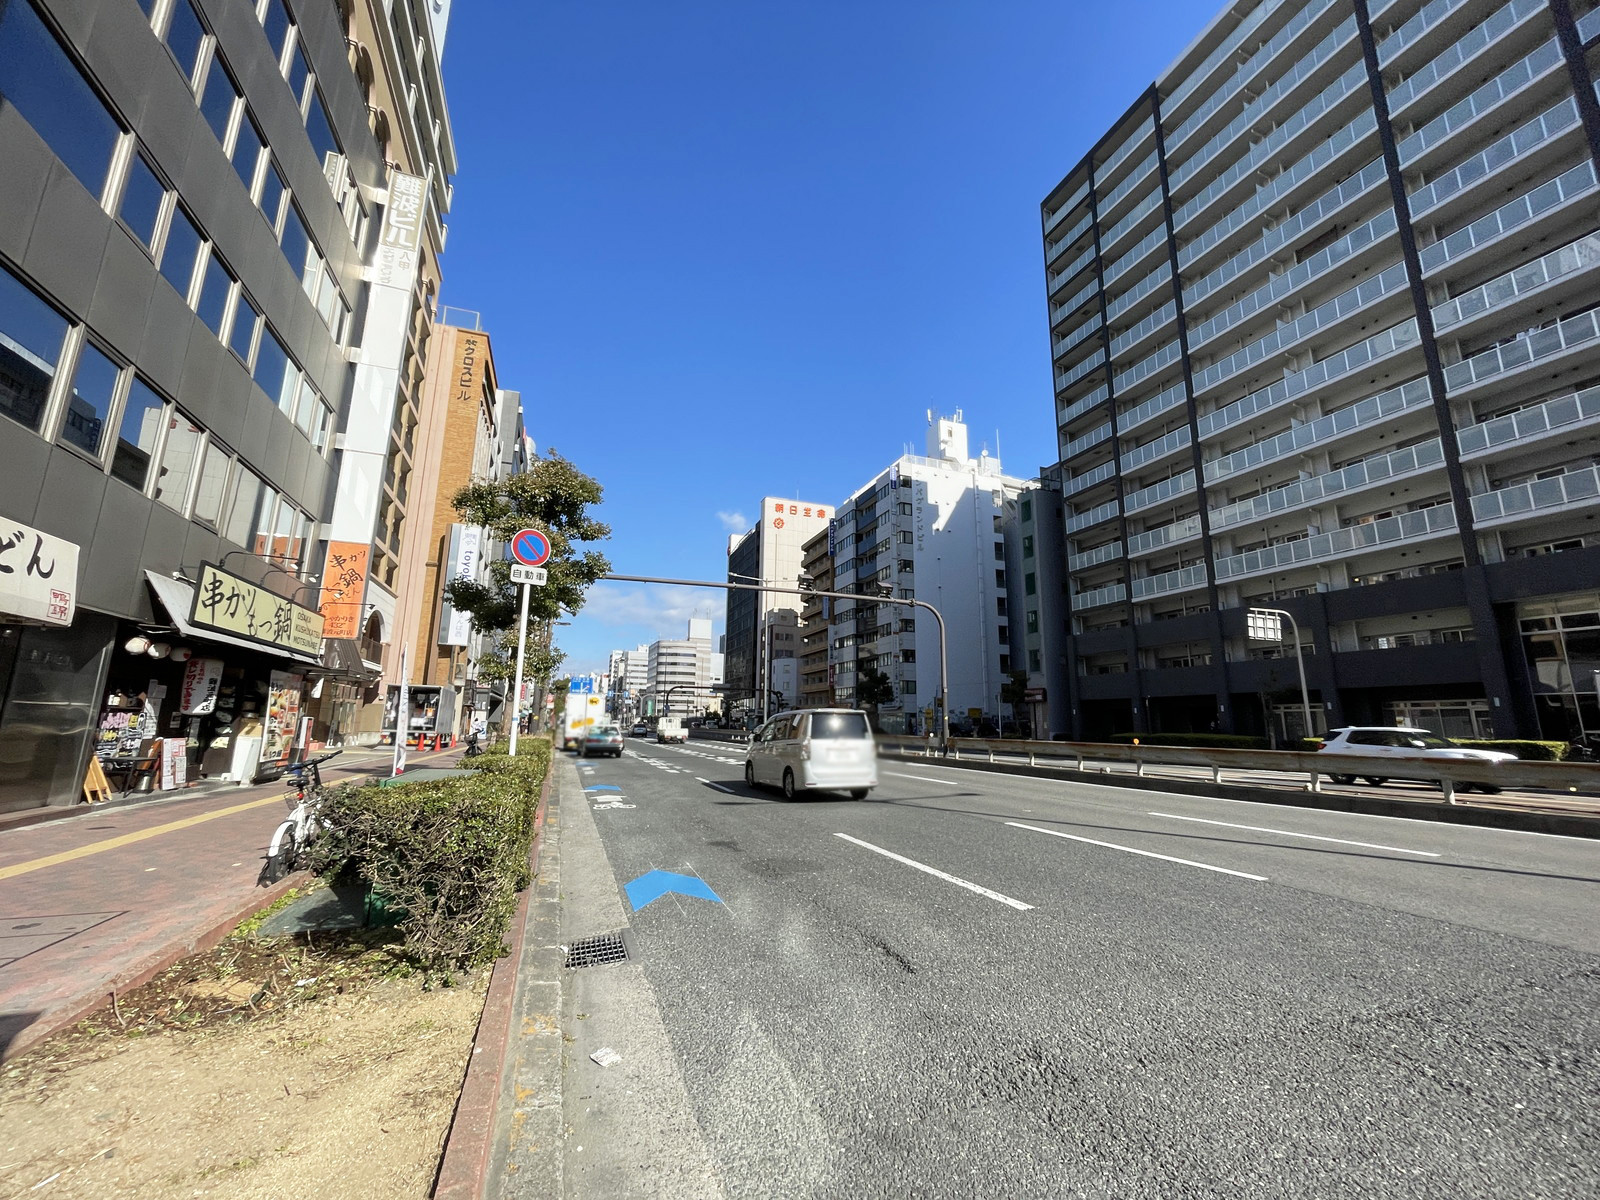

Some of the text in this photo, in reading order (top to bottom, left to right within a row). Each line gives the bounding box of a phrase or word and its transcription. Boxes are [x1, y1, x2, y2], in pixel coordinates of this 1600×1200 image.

[388, 174, 421, 247] 難波ビル
[775, 503, 826, 519] 朝日生命
[461, 549, 475, 581] toyok
[512, 569, 545, 581] 自動車
